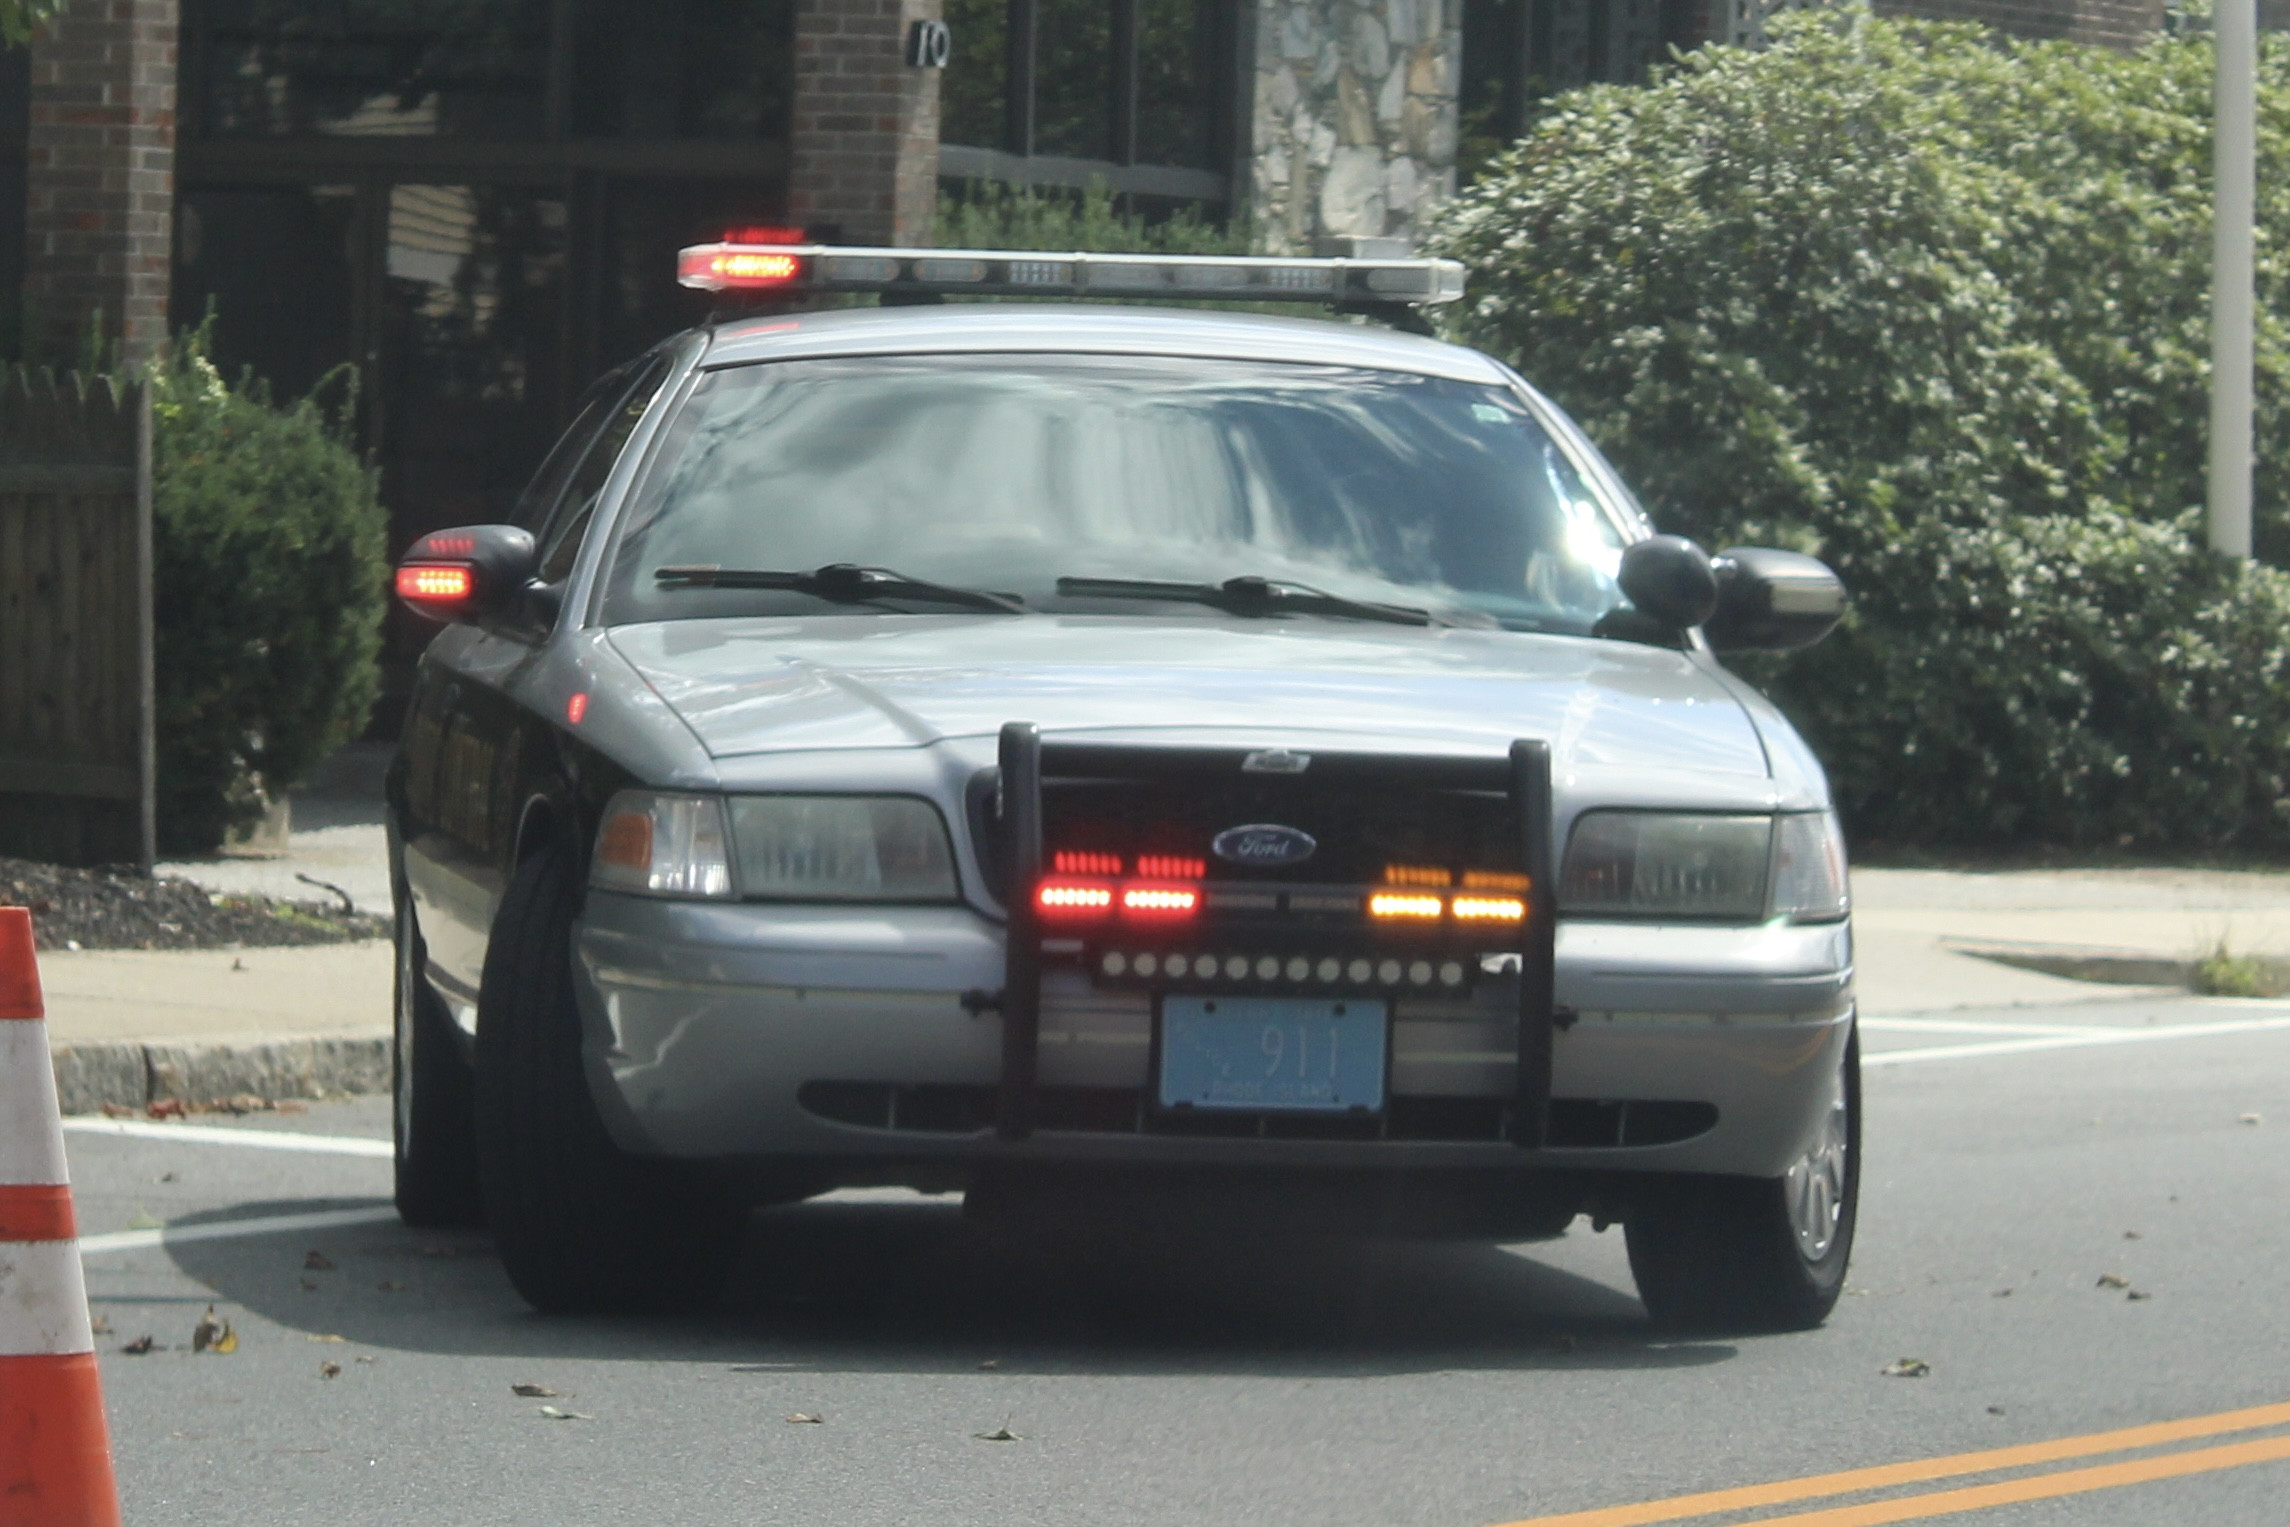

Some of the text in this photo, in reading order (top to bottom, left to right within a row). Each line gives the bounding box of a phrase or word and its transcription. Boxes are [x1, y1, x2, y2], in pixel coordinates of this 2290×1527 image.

[916, 20, 951, 69] 10
[1237, 833, 1290, 856] Ford
[1260, 1025, 1338, 1079] 911
